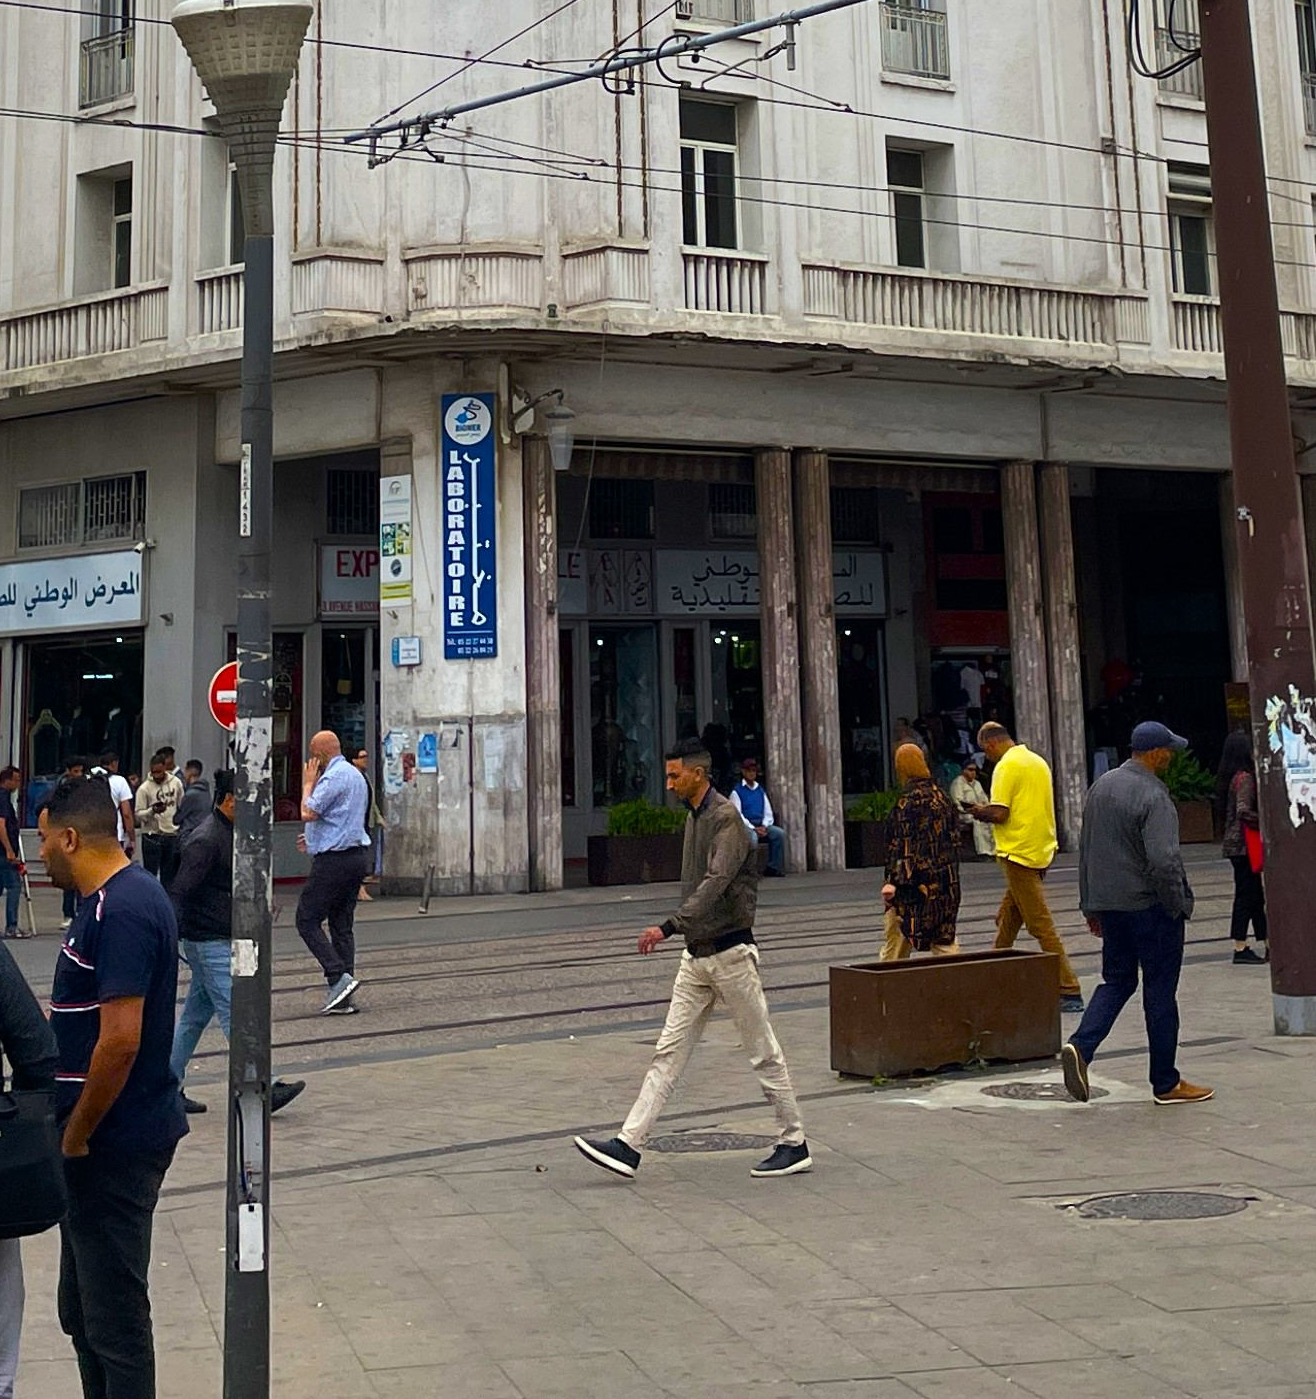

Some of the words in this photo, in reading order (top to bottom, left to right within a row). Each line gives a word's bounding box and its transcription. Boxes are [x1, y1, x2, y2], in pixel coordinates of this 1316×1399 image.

[447, 450, 465, 627] LABORATOIRE
[337, 549, 381, 578] EXP
[24, 577, 78, 618] الوطني
[84, 570, 140, 608] المعرض
